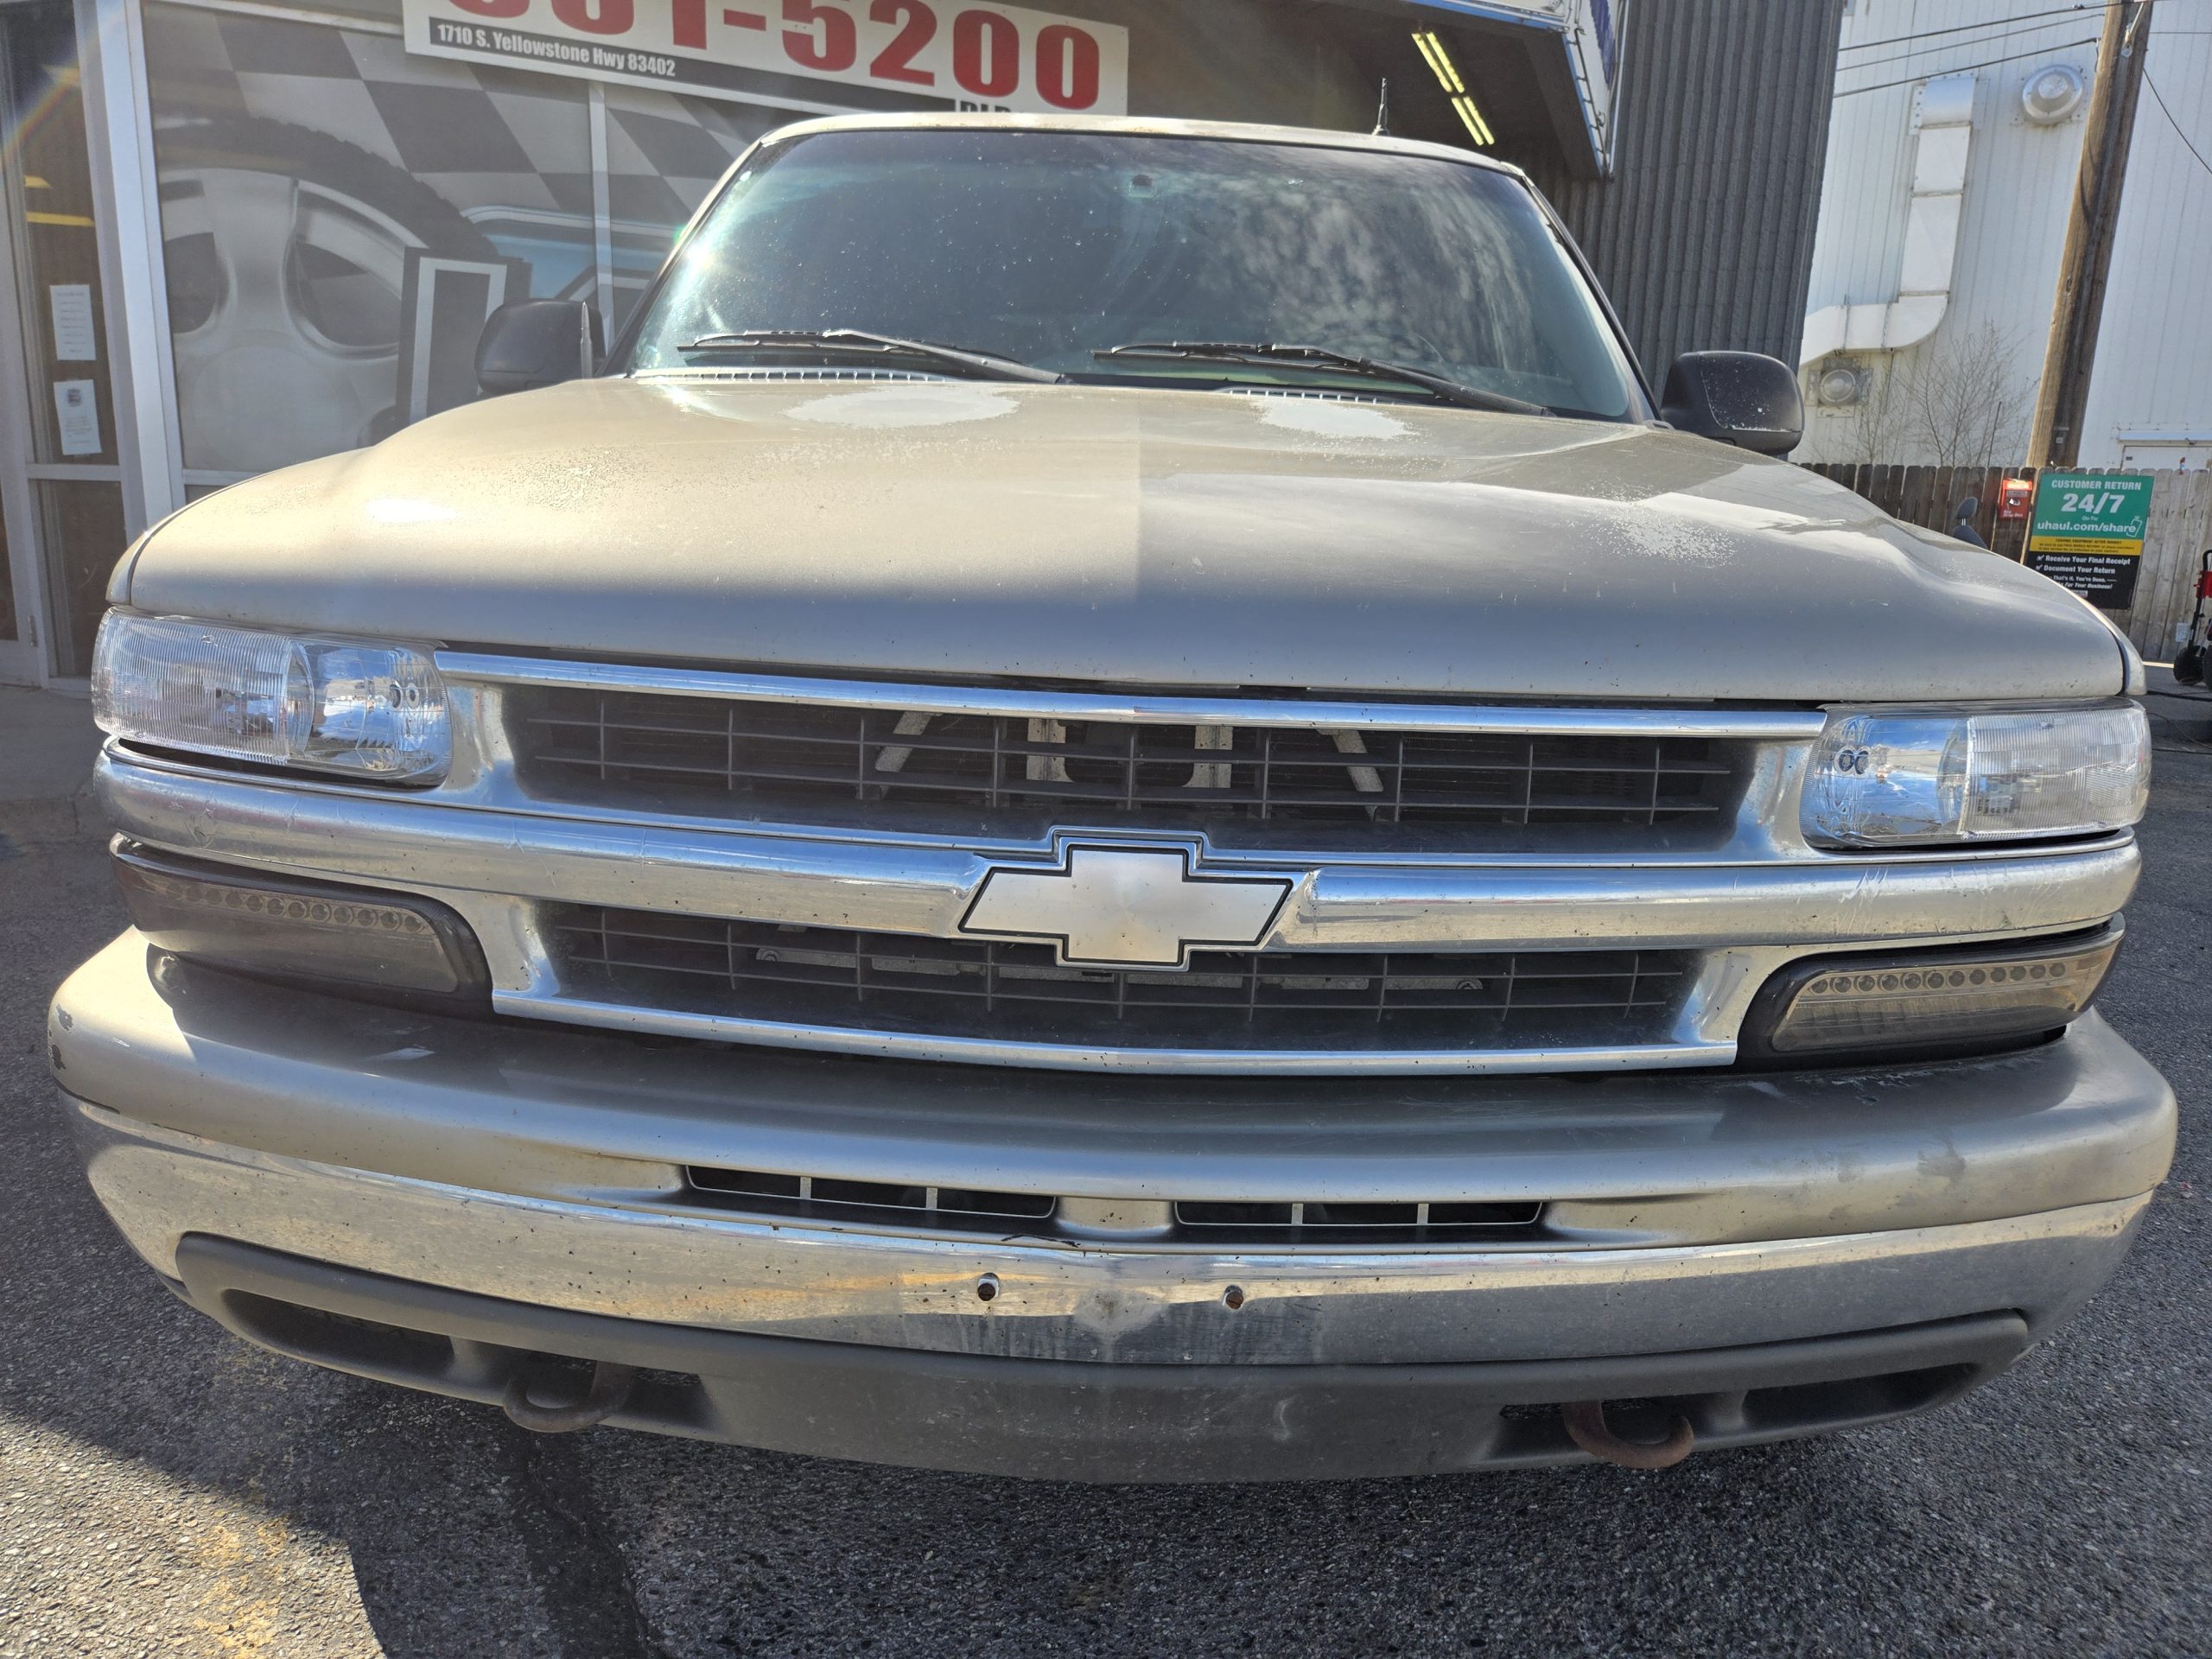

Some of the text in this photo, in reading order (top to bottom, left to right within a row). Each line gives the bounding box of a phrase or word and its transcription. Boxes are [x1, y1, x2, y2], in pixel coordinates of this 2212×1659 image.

[437, 24, 677, 77] 1710 S. Yellowstone Hwy 83402
[2051, 480, 2141, 490] CUSTOMER RETURN
[2061, 492, 2125, 514] 24/7
[2037, 520, 2137, 533] uhaul.com/share
[2106, 557, 2131, 566] Receipt
